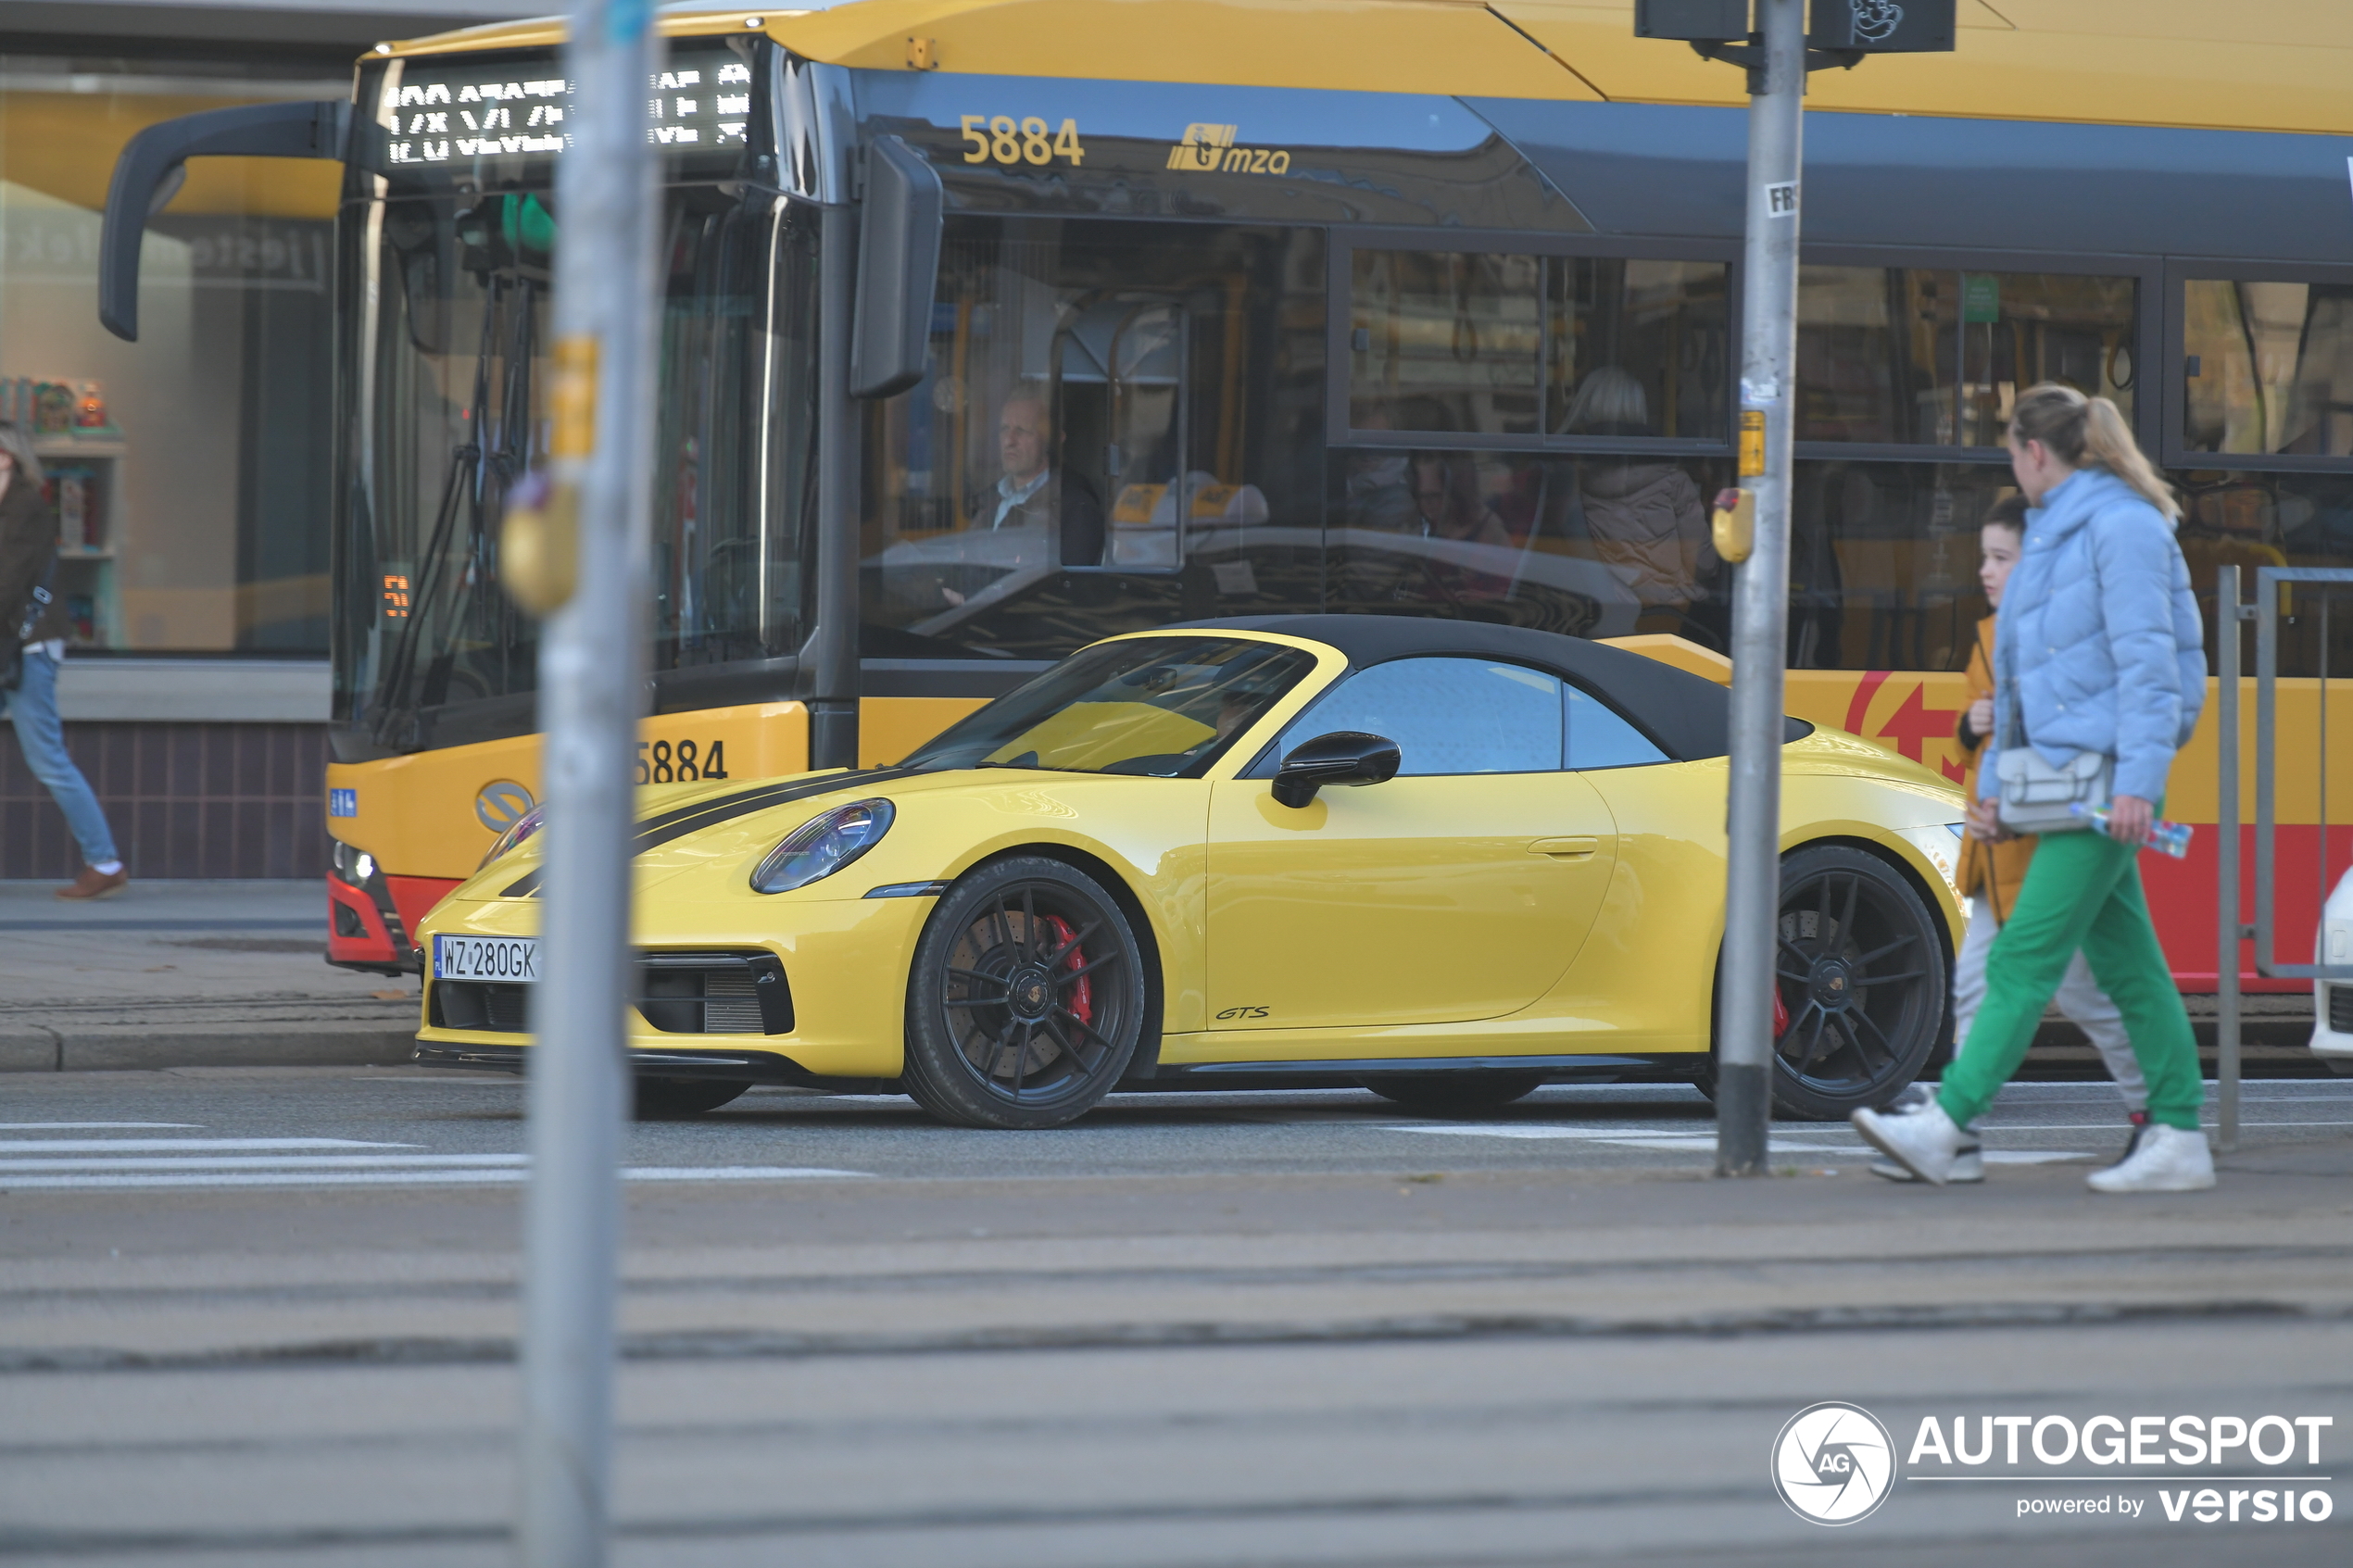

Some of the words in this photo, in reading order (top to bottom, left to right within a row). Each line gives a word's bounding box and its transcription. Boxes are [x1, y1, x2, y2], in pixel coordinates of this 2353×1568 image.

[960, 115, 1085, 166] 5884
[1222, 147, 1290, 175] mza
[634, 739, 728, 785] 5884
[1215, 1006, 1270, 1020] GTS
